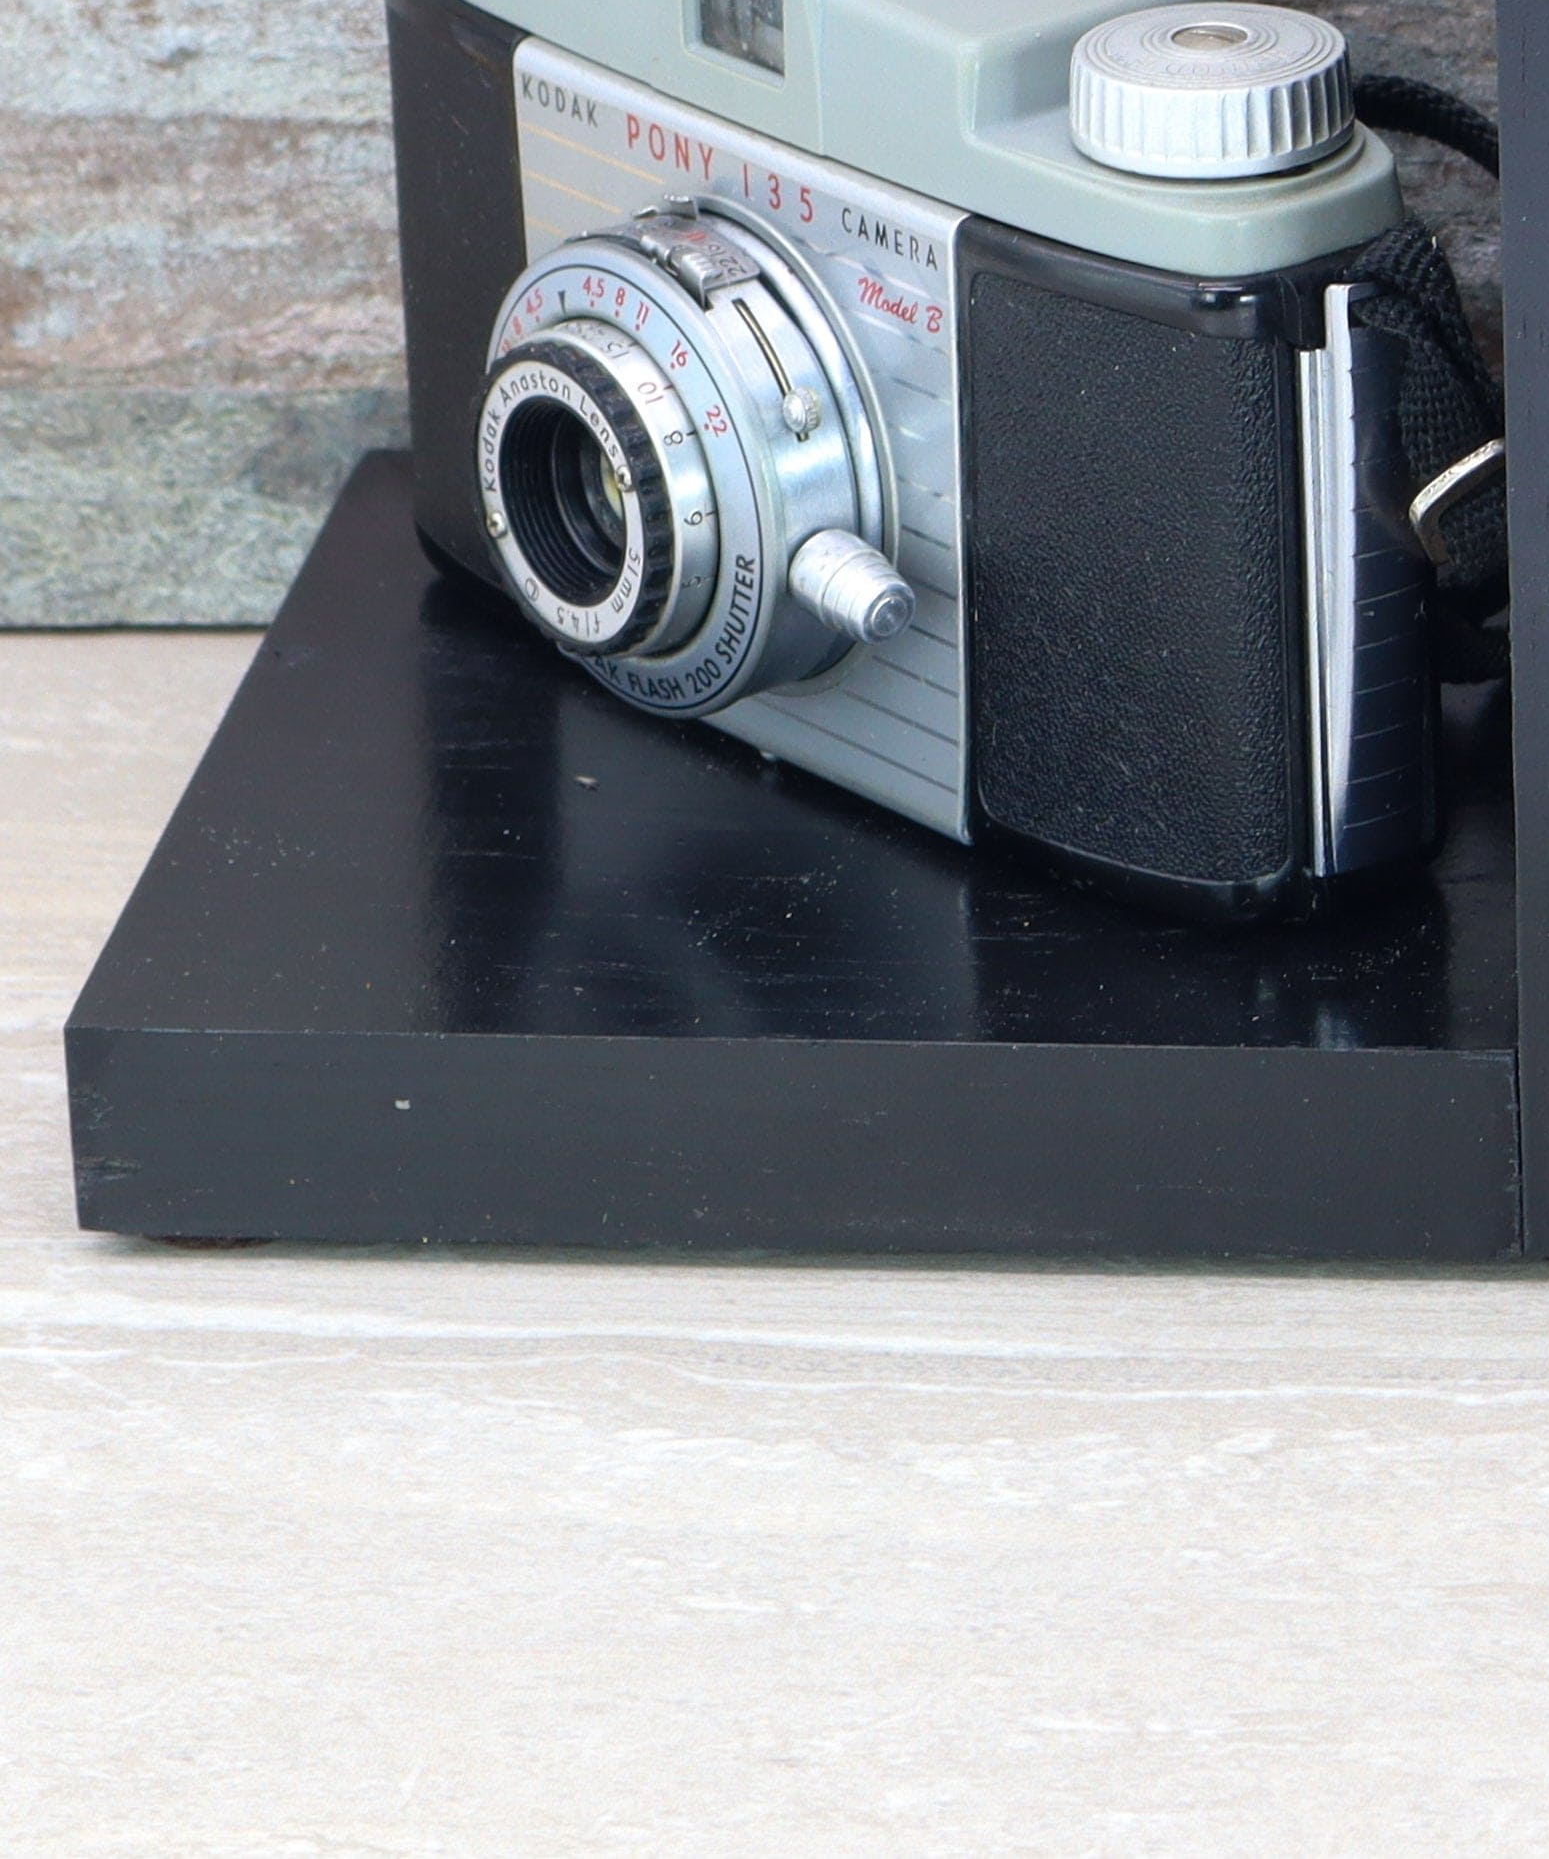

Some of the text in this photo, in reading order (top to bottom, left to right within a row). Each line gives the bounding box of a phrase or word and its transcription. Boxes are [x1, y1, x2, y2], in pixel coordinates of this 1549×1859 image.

[519, 72, 940, 272] KODAK PONY 135 CAMERA
[582, 275, 605, 298] 4.5
[615, 287, 627, 307] 8
[671, 339, 688, 367] 16
[705, 404, 729, 437] 22
[857, 276, 944, 334] Model B
[484, 412, 503, 492] Kodak
[499, 370, 572, 408] Anaston
[579, 396, 620, 459] Lens
[626, 671, 686, 701] FLASH
[685, 658, 722, 694] 200
[715, 553, 756, 665] SHUTTER
